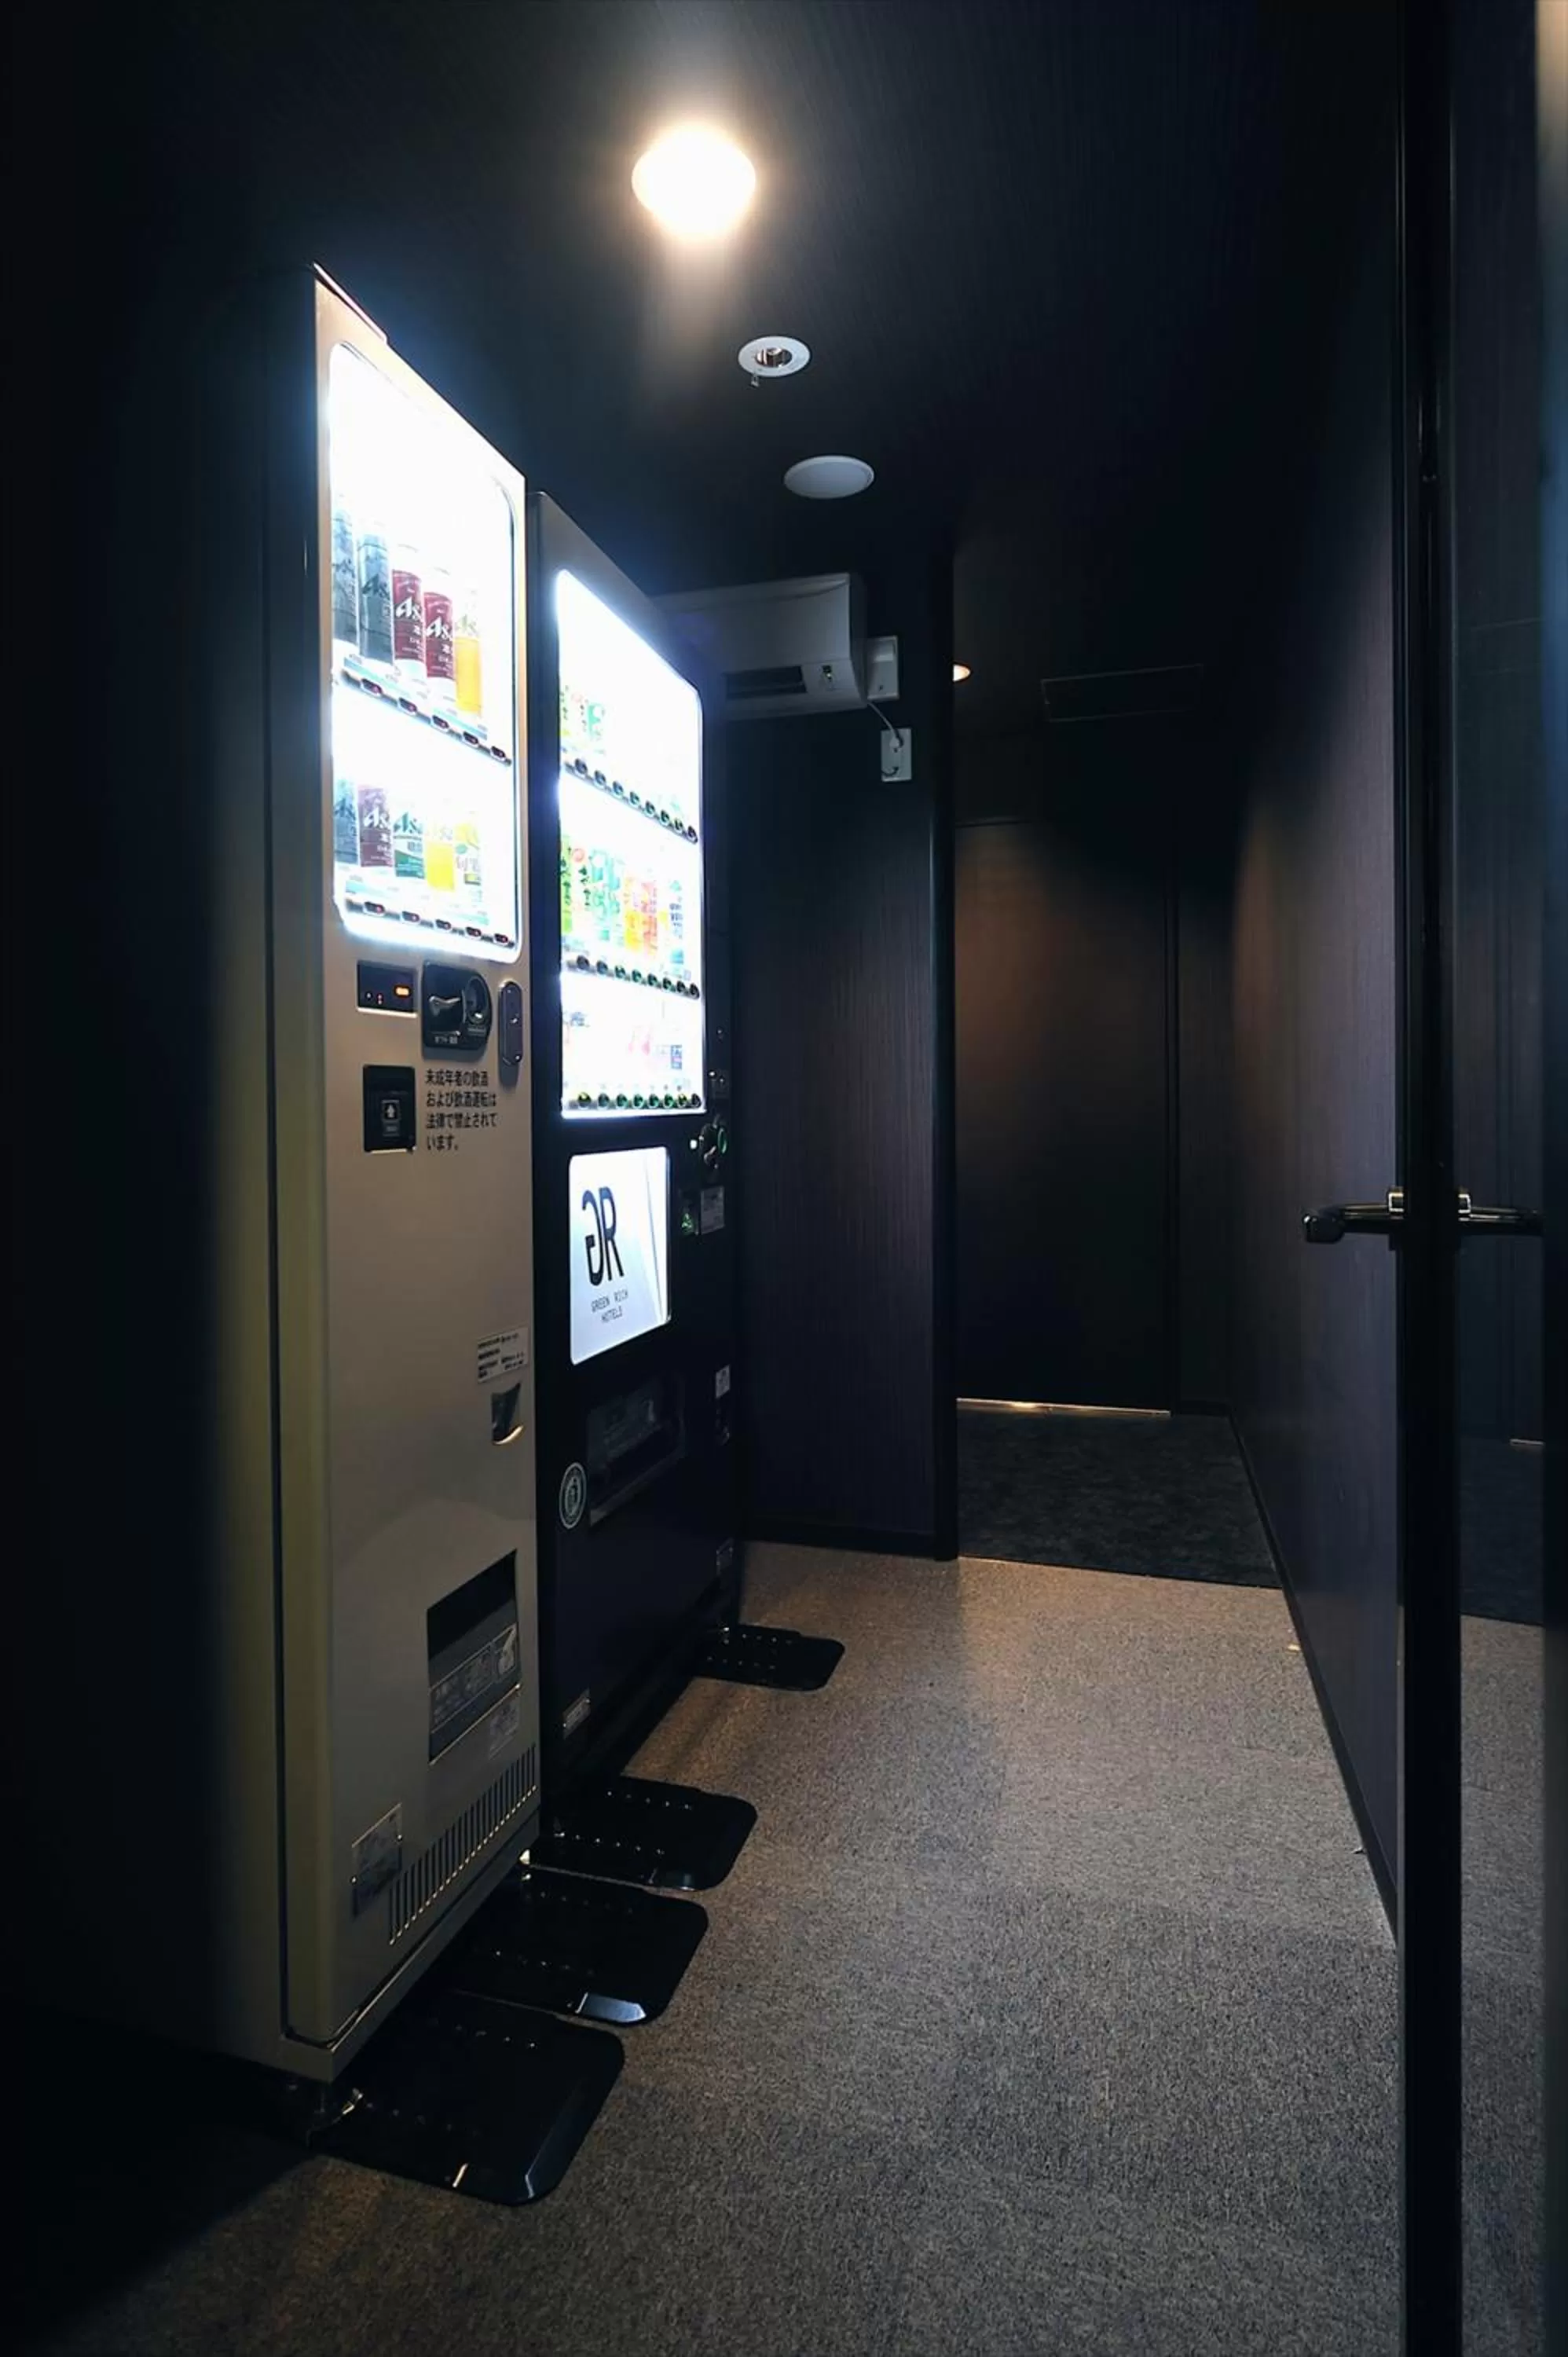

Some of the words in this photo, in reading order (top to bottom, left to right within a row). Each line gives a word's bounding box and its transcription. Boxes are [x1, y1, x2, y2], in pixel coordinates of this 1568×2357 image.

[426, 1069, 488, 1086] 未成年者の飲酒
[427, 1091, 496, 1108] および飲酒運転は
[426, 1113, 497, 1129] 法律で禁止されて
[427, 1135, 459, 1151] います。
[591, 1296, 610, 1313] GREEN
